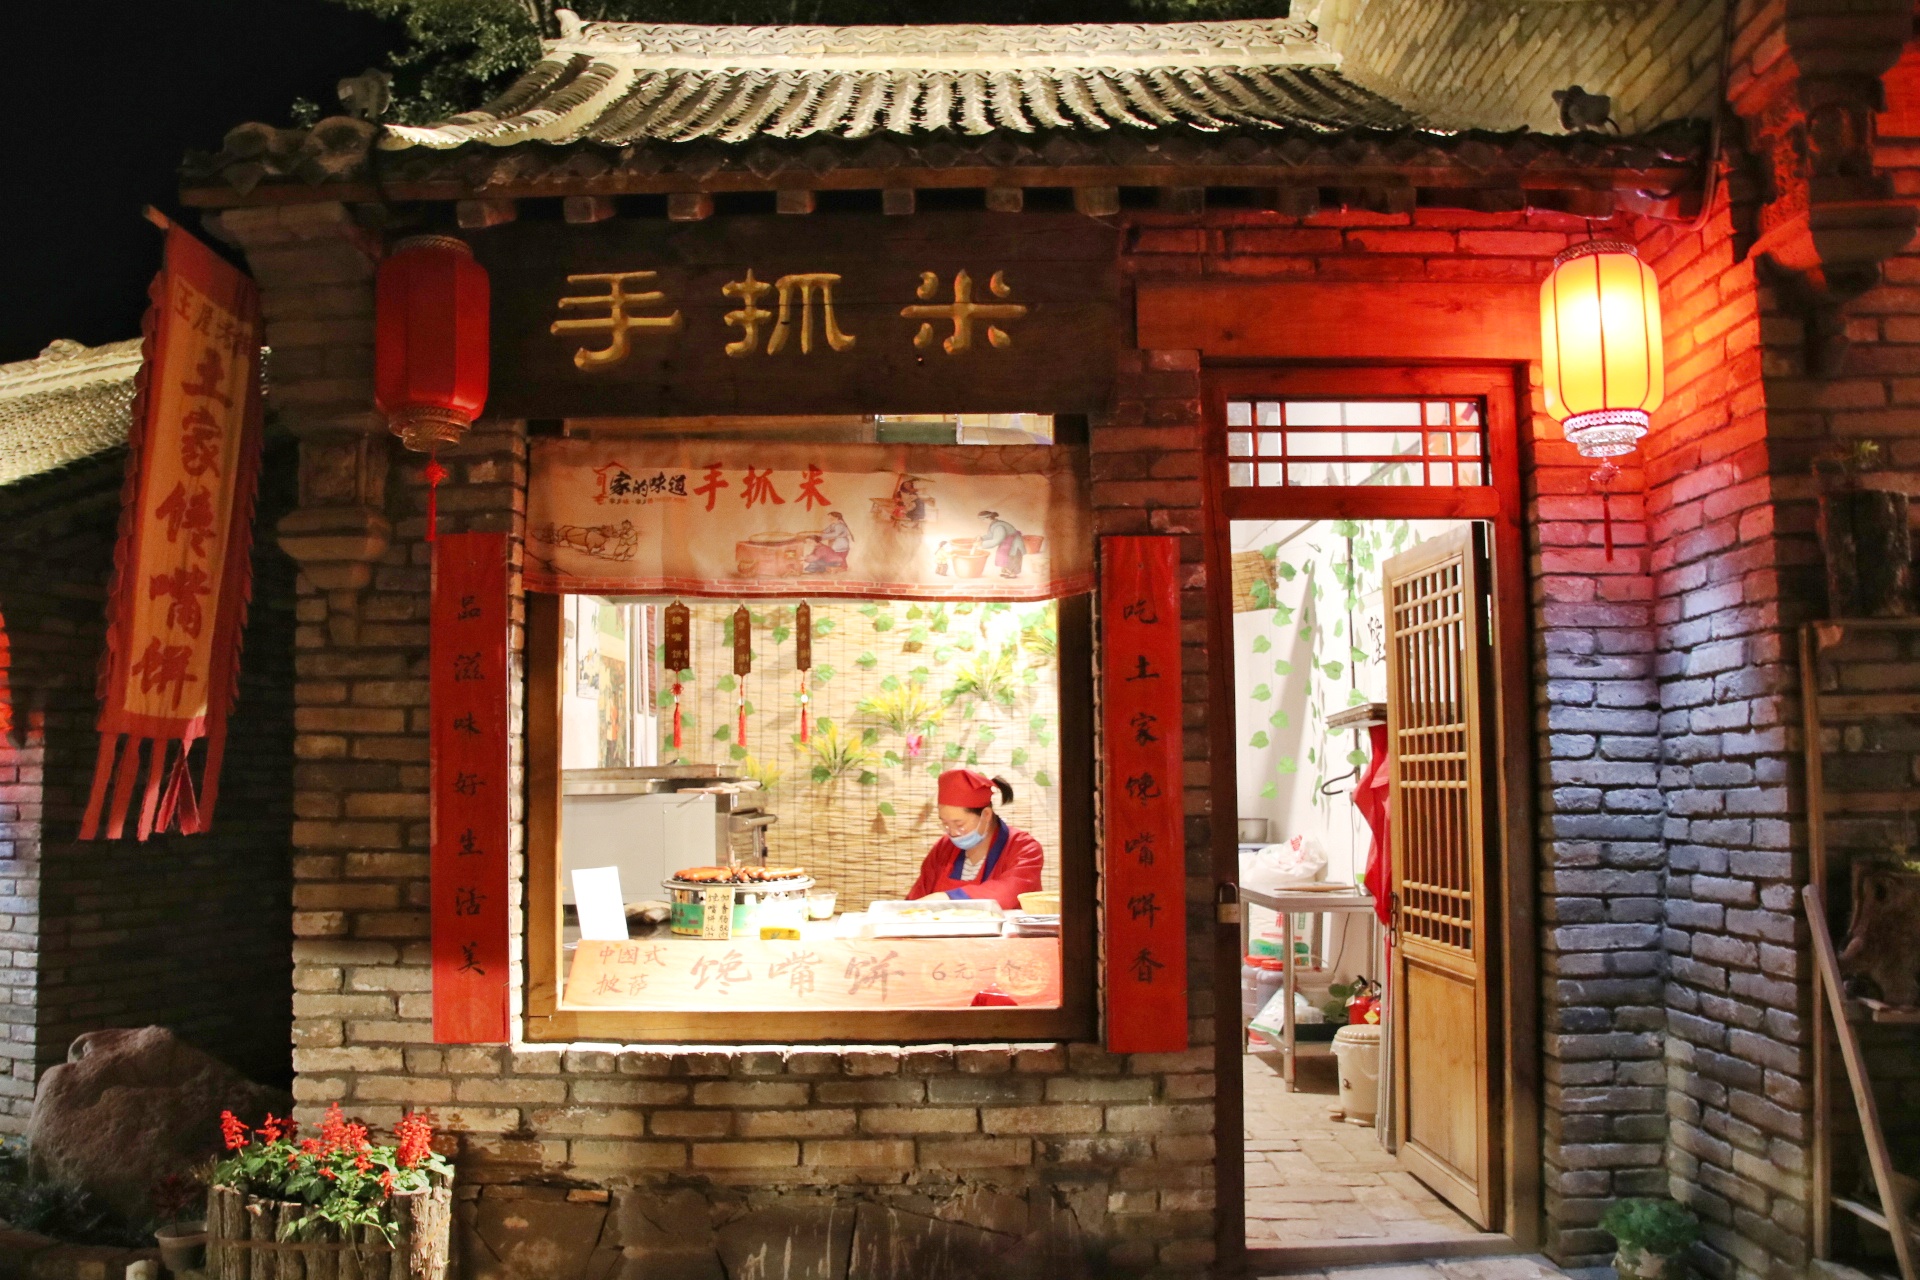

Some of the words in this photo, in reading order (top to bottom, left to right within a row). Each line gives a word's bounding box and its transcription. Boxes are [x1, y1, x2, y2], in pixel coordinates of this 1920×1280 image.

[551, 268, 1027, 371] 手抓米
[693, 462, 832, 512] 手抓米
[453, 595, 487, 975] 品滋味好生活美
[1124, 600, 1163, 984] 吃土家馋嘴饼香
[592, 973, 649, 997] 披萨
[690, 948, 906, 1002] 馋嘴饼
